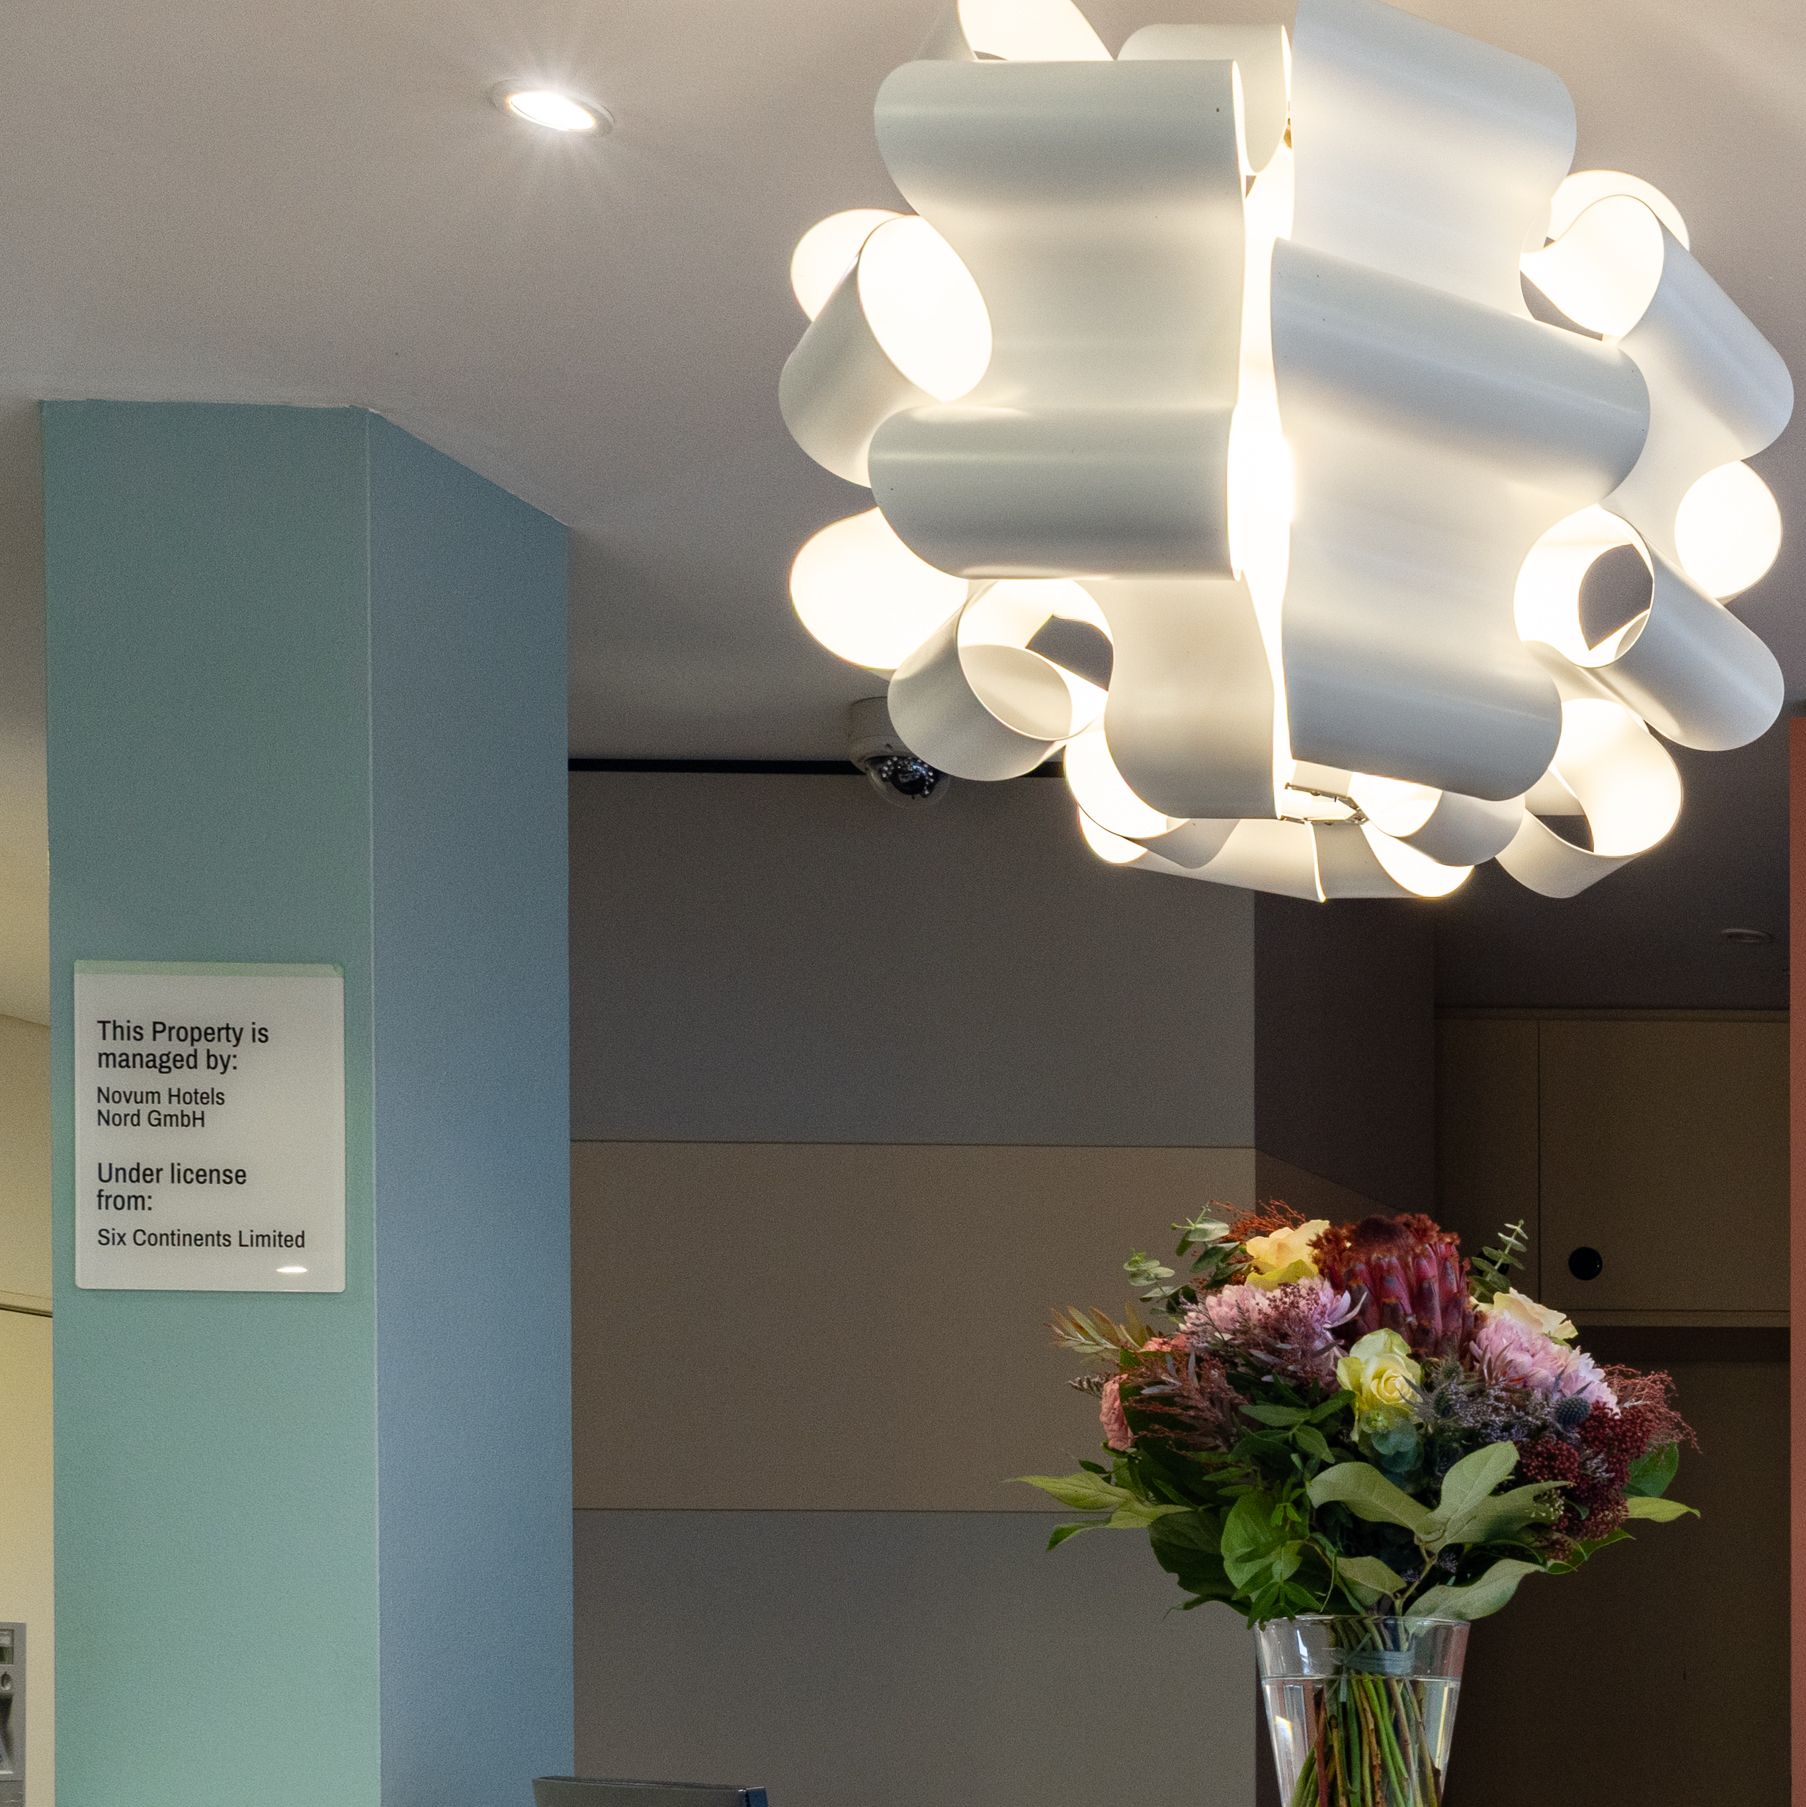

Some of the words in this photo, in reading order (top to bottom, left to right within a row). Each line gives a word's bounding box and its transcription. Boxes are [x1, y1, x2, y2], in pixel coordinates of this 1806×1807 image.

[96, 1019, 144, 1042] This
[152, 1020, 244, 1048] Property
[251, 1021, 269, 1043] is
[97, 1048, 198, 1074] managed
[206, 1048, 239, 1074] by:
[96, 1086, 161, 1105] Novum
[168, 1087, 225, 1105] Hotels
[97, 1108, 141, 1127] Nord
[147, 1109, 205, 1128] GmbH
[97, 1162, 164, 1184] Under
[170, 1162, 247, 1185] license
[96, 1188, 153, 1211] from:
[97, 1228, 126, 1247] Six
[132, 1228, 232, 1248] Continents
[238, 1229, 305, 1249] Limited
